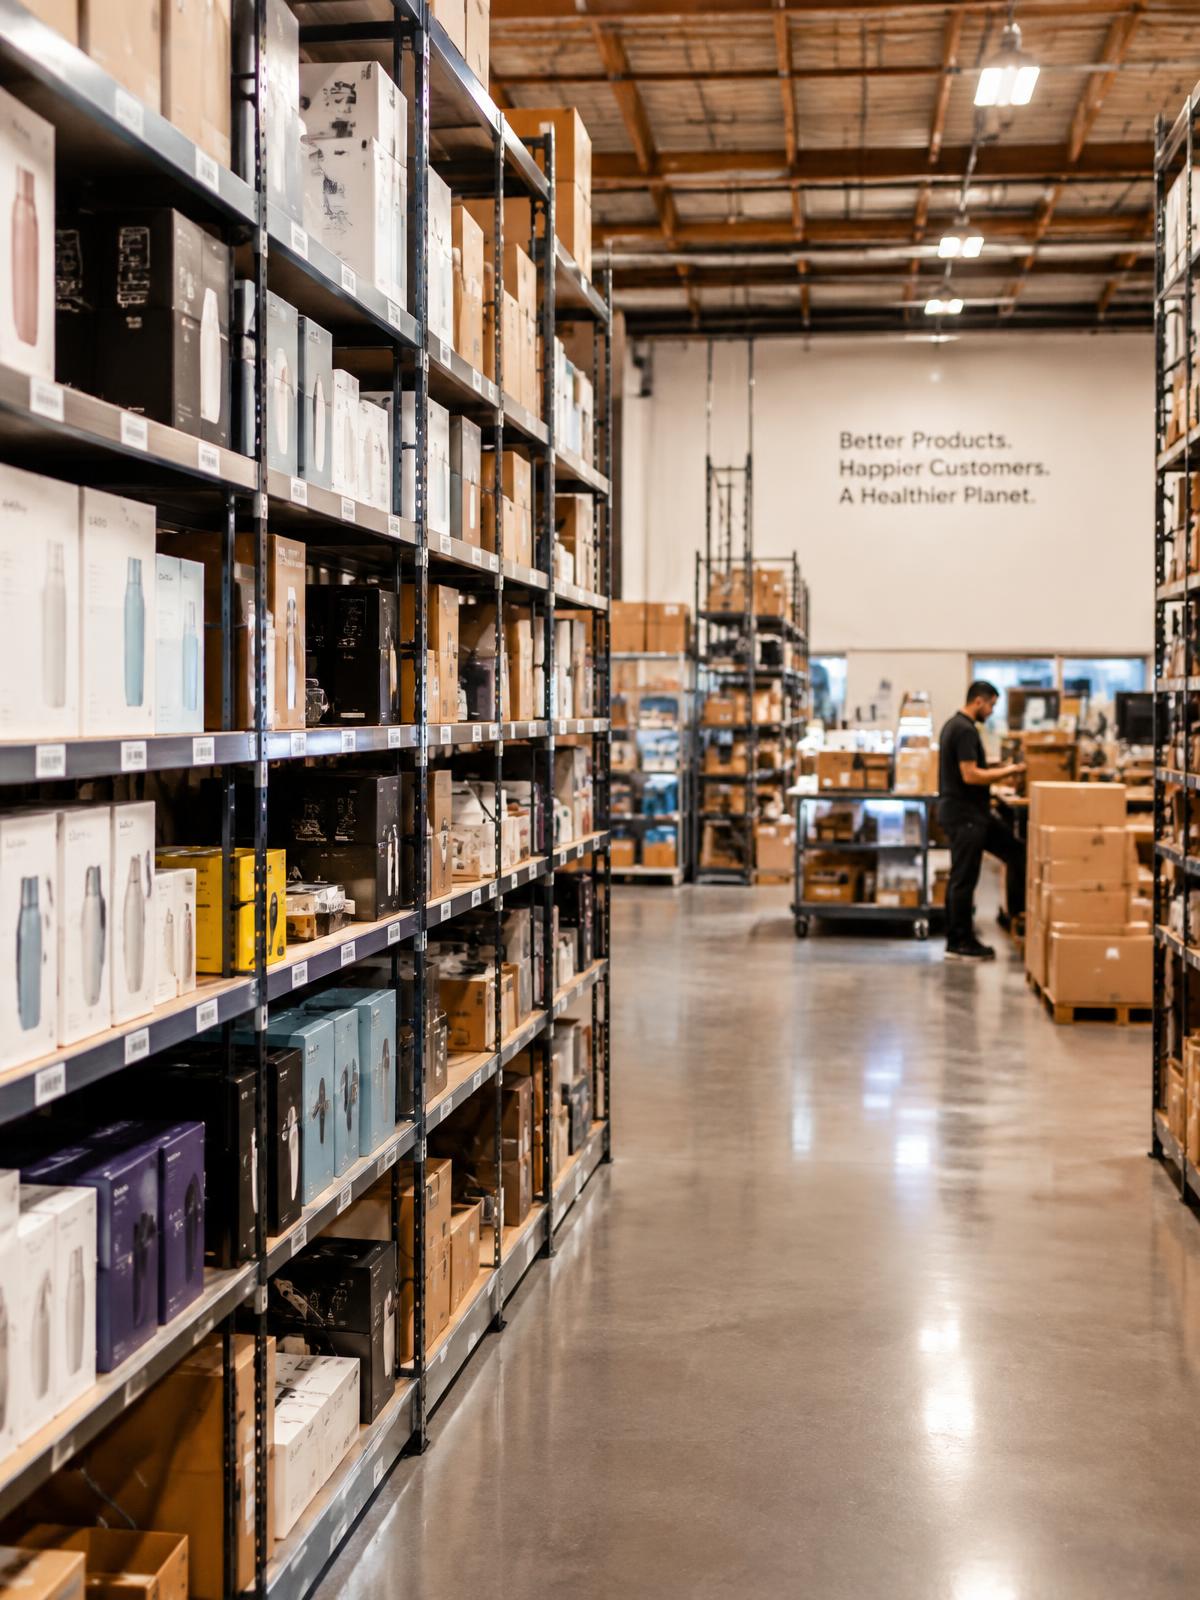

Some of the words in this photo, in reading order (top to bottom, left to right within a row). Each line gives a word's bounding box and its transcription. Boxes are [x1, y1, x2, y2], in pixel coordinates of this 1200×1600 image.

[840, 431, 904, 450] Better
[912, 431, 1011, 449] Products.
[840, 460, 923, 481] Happier
[929, 459, 1049, 477] Customers.
[839, 487, 854, 504] A
[861, 486, 957, 504] Healthier
[964, 486, 1034, 504] Planet.
